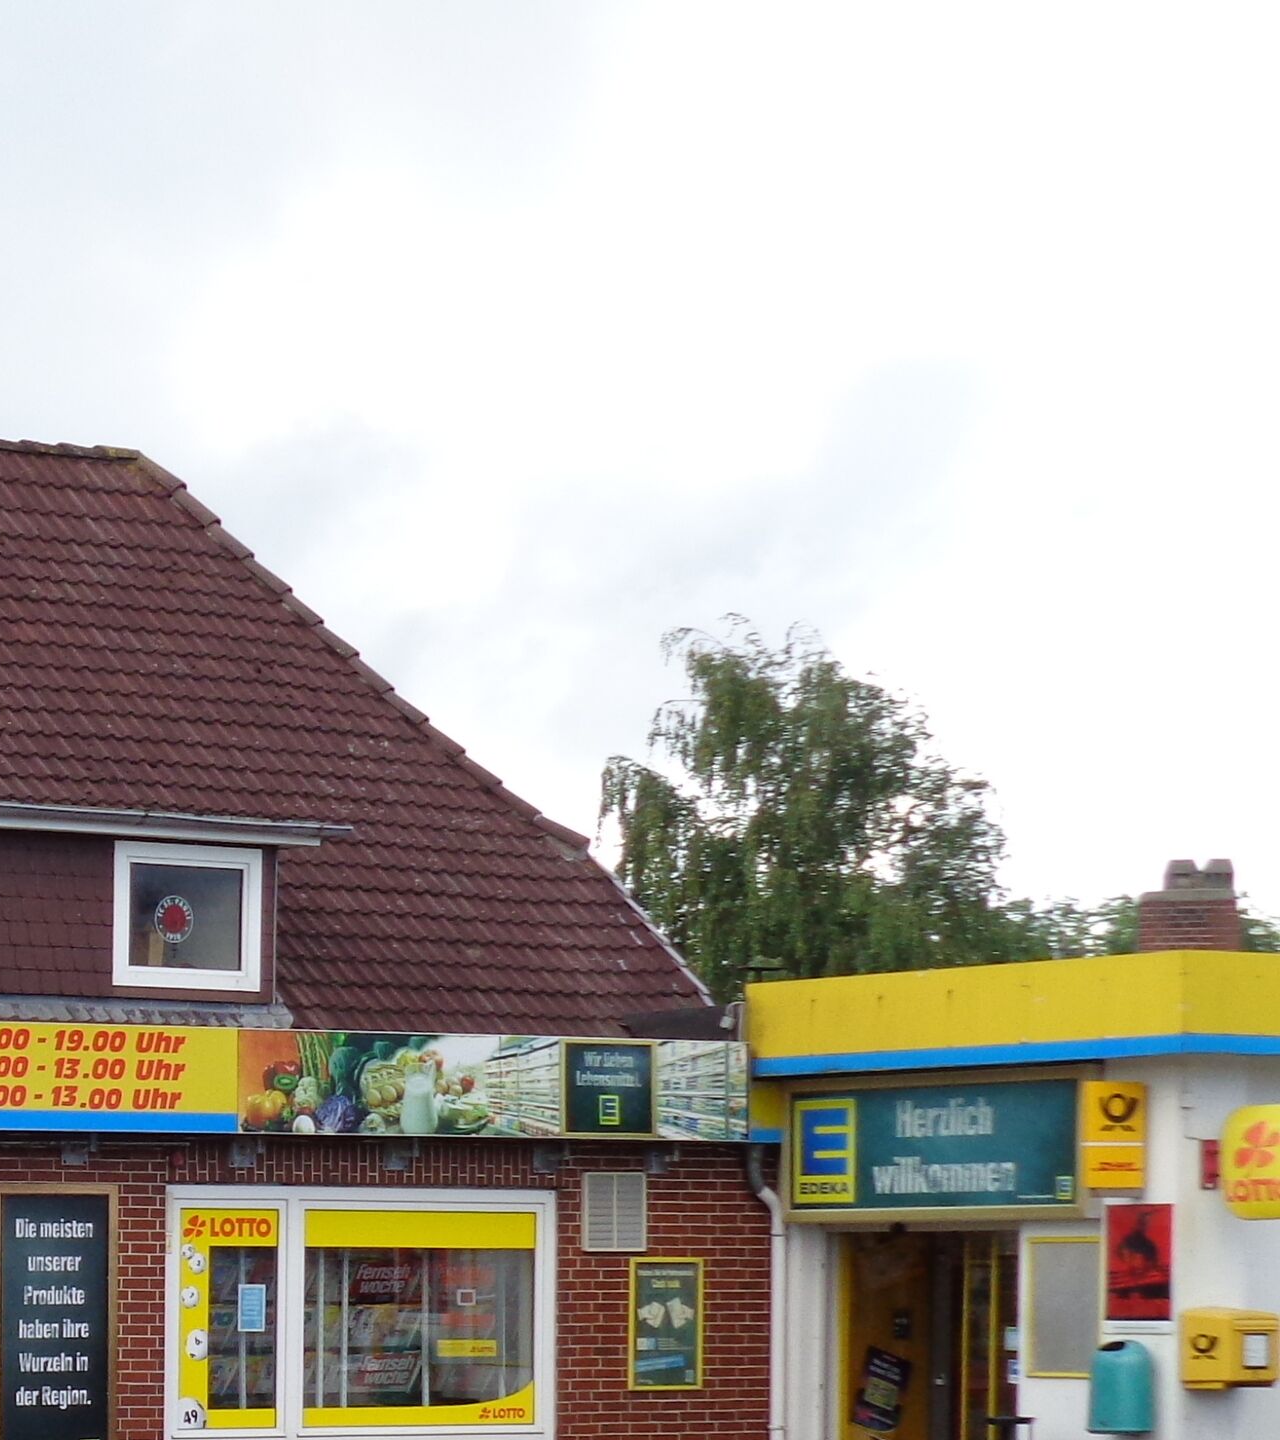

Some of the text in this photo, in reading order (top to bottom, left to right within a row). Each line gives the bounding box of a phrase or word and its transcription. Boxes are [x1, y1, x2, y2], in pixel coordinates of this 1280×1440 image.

[54, 1030, 126, 1052] 19.00
[135, 1032, 186, 1054] Uhr
[53, 1058, 126, 1080] 13.00
[135, 1059, 186, 1081] Uhr
[51, 1086, 123, 1110] 13.00
[132, 1088, 182, 1110] Uhr
[895, 1097, 994, 1138] Herzlich
[802, 1108, 848, 1175] E
[872, 1156, 1017, 1194] willkommen
[799, 1182, 850, 1194] EDEKA
[15, 1218, 93, 1238] Die meisten
[210, 1217, 272, 1238] LOTTO
[27, 1255, 82, 1272] unserer
[23, 1285, 86, 1305] Produkte
[360, 1277, 406, 1294] woche
[18, 1318, 89, 1339] haben ihre
[18, 1351, 89, 1372] Wurzeln in
[15, 1385, 92, 1410] der Region.
[183, 1409, 198, 1424] 49
[493, 1407, 526, 1419] LOTTO
